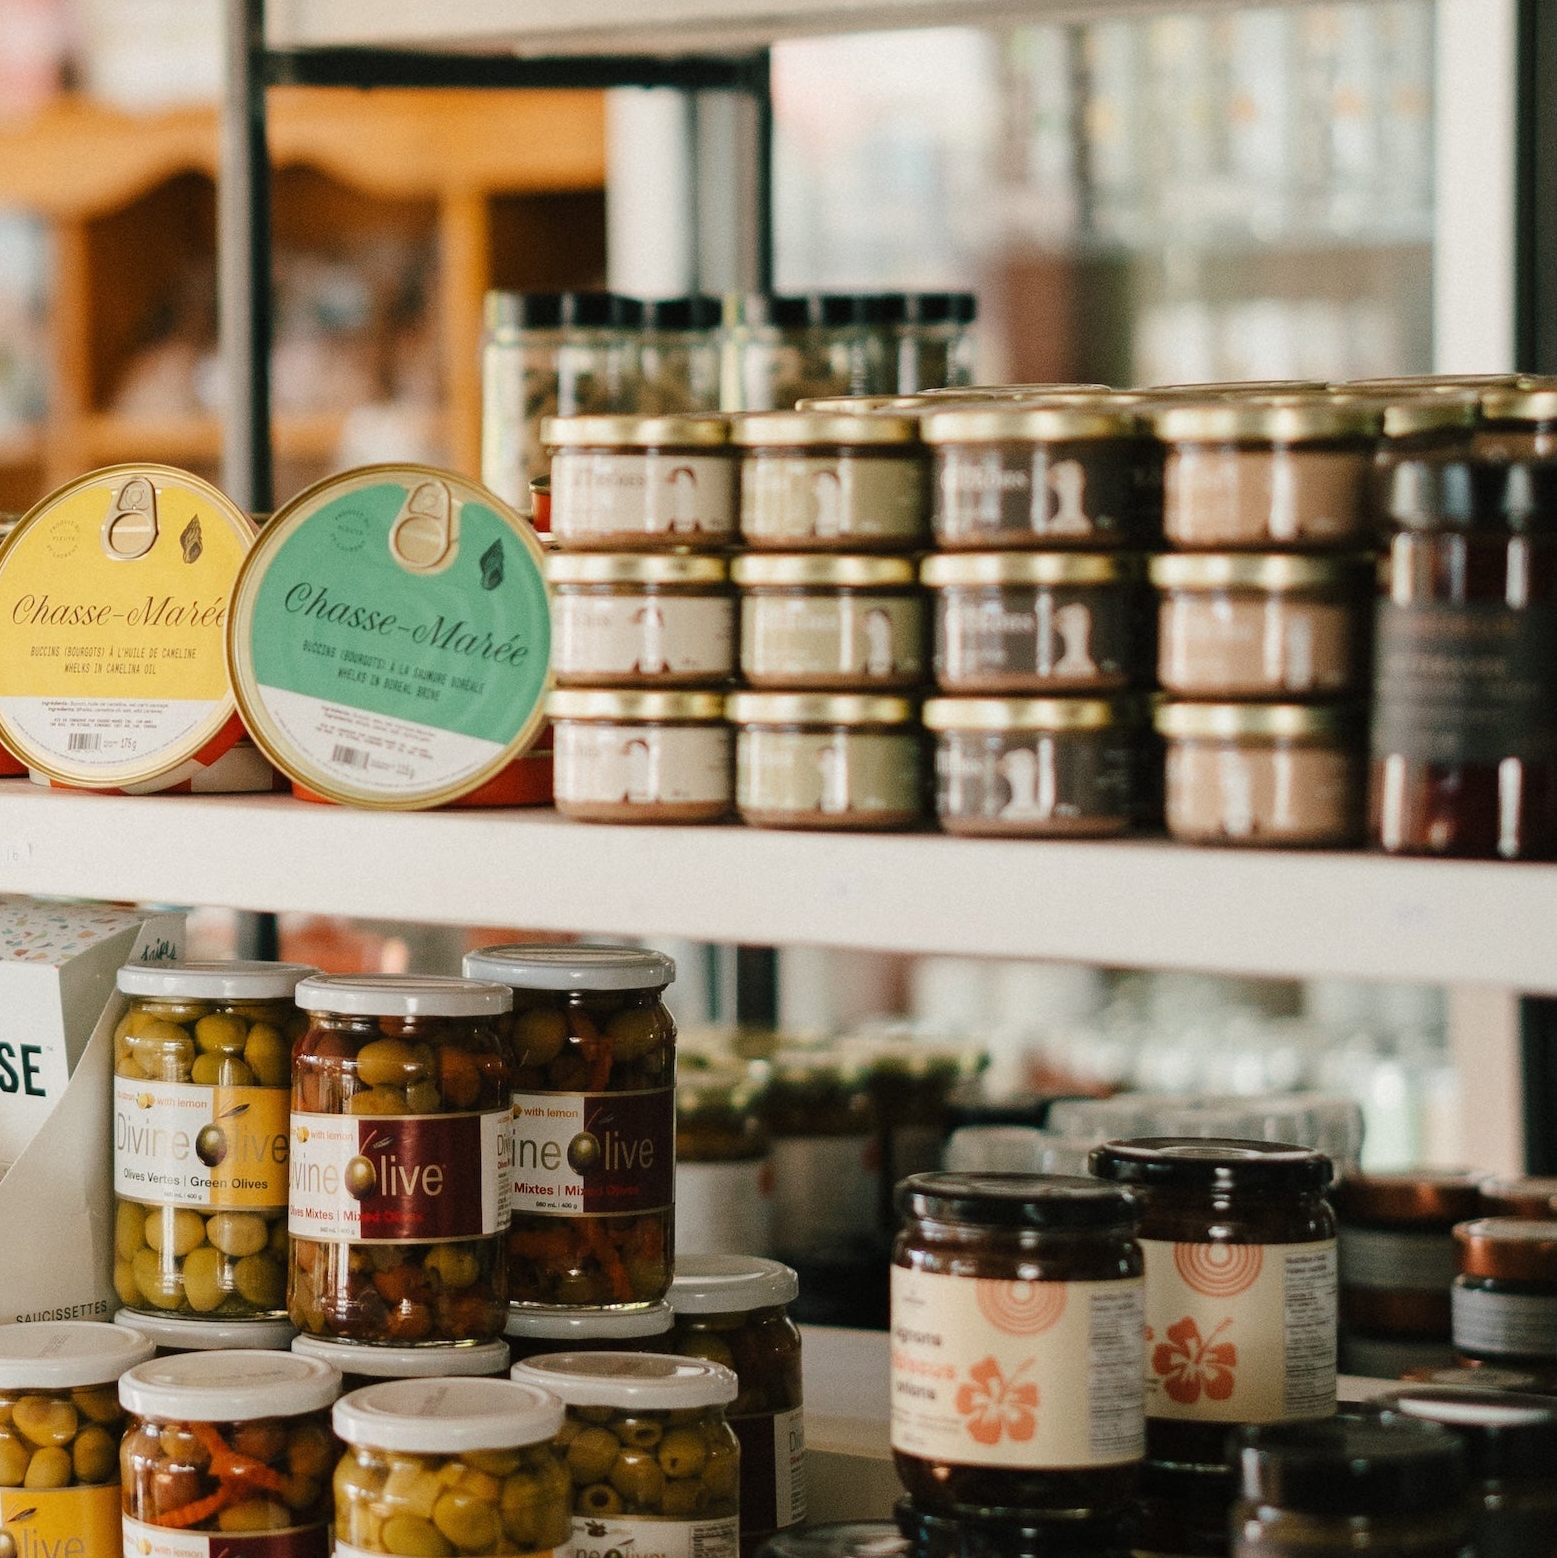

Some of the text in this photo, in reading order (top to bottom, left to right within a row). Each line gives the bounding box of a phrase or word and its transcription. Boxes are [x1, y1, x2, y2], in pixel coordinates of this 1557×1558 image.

[12, 595, 226, 627] Chasse-Marée
[284, 582, 530, 667] Chasse-Marée
[31, 646, 60, 657] BUCCINS
[64, 647, 105, 659] (BOURGOTS)
[118, 647, 145, 658] L'HUILE
[149, 648, 157, 658] DE
[162, 649, 196, 659] CAMELINE
[65, 664, 156, 675] WHELKS IN CAMELINA OIL
[157, 1098, 207, 1109] with lemon
[524, 1107, 578, 1118] with lemon
[117, 1112, 190, 1160] Divine
[310, 1132, 354, 1141] with lemon
[124, 1167, 268, 1189] Olives Vertes Green Olives
[514, 1182, 554, 1195] Mixtes
[305, 1209, 334, 1220] Mixtes
[16, 1300, 107, 1324] SAUCISSETTES
